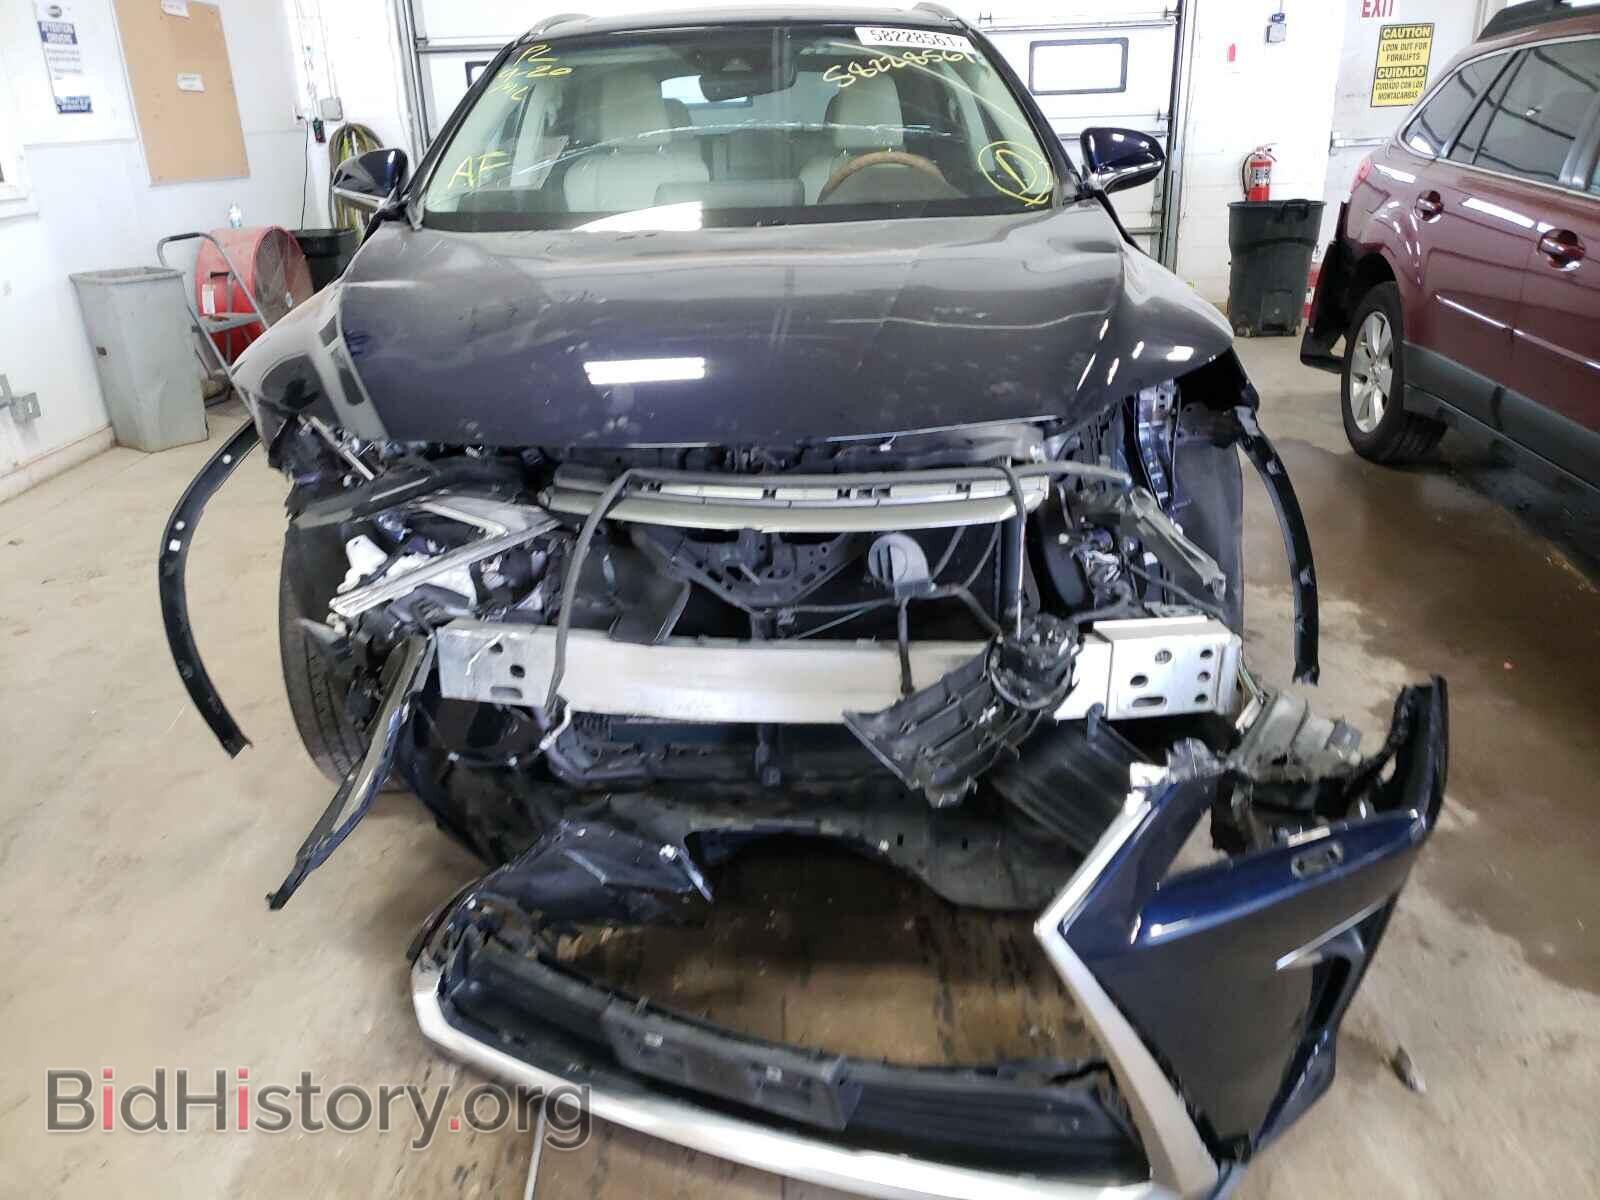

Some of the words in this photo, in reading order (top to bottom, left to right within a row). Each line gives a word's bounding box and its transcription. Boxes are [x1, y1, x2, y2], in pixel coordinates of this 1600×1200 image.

[1383, 27, 1431, 39] CAUTION
[1382, 43, 1398, 52] LOOK
[1400, 42, 1414, 51] OUT
[1415, 41, 1428, 50] FOR
[1386, 52, 1421, 62] FORKLIFTS
[1377, 66, 1425, 78] CUIDADO
[1375, 81, 1399, 90] CUIDADO
[1401, 81, 1411, 89] CON
[1413, 80, 1423, 88] LOS
[1377, 91, 1418, 100] MONTACARGAS
[448, 150, 510, 189] AF
